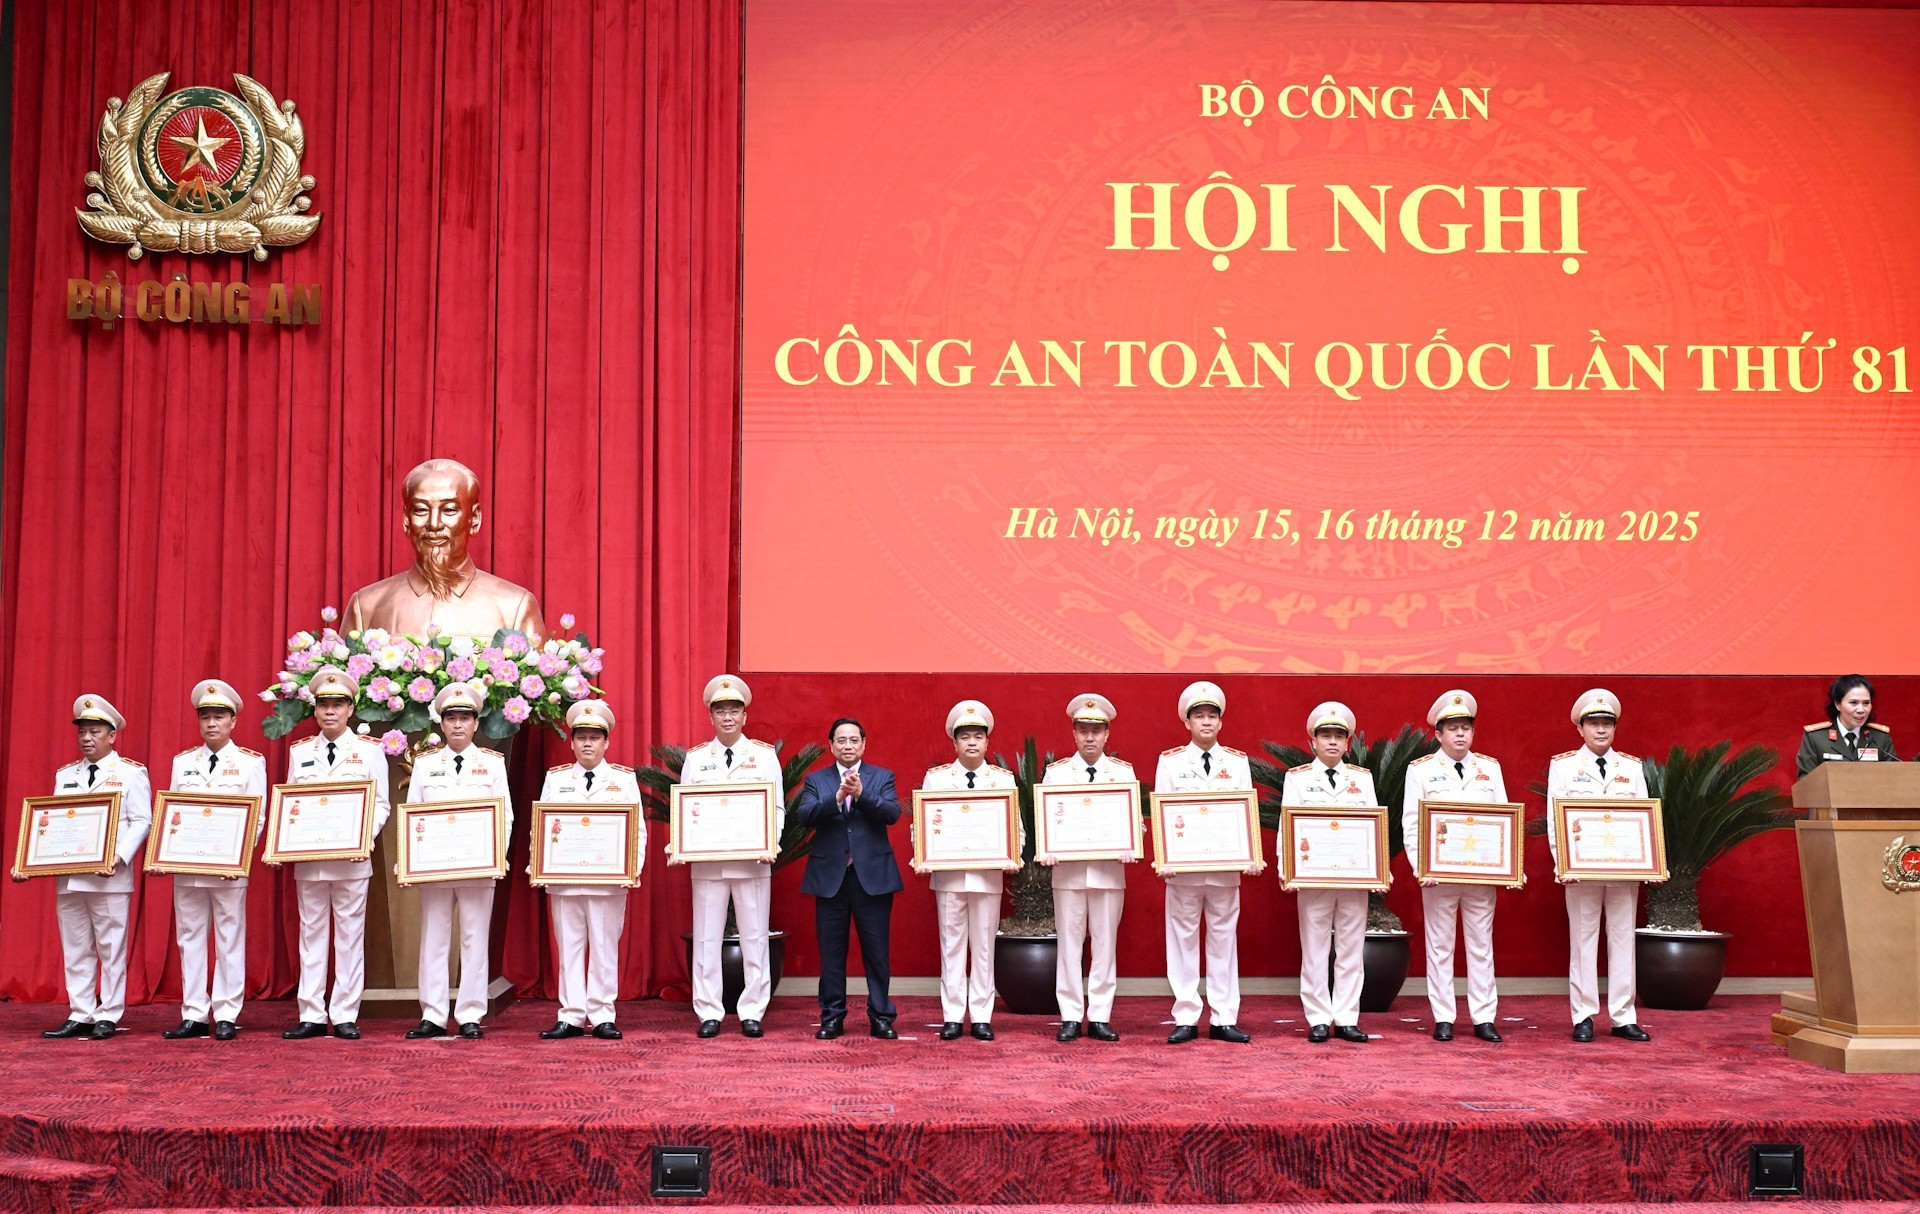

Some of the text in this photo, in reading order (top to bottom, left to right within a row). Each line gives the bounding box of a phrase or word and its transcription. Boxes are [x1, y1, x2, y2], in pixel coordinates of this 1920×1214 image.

[1198, 74, 1491, 127] BỘ CÔNG AN
[1104, 170, 1589, 275] HỘI NGHỊ
[67, 270, 323, 330] BỘ CÔNG AN
[774, 323, 1913, 401] CÔNG AN TOÀN QUỐC LẦN THỨ 81
[1002, 507, 1700, 549] Hà Nội, ngày 15, 16 tháng 12 năm 2025
